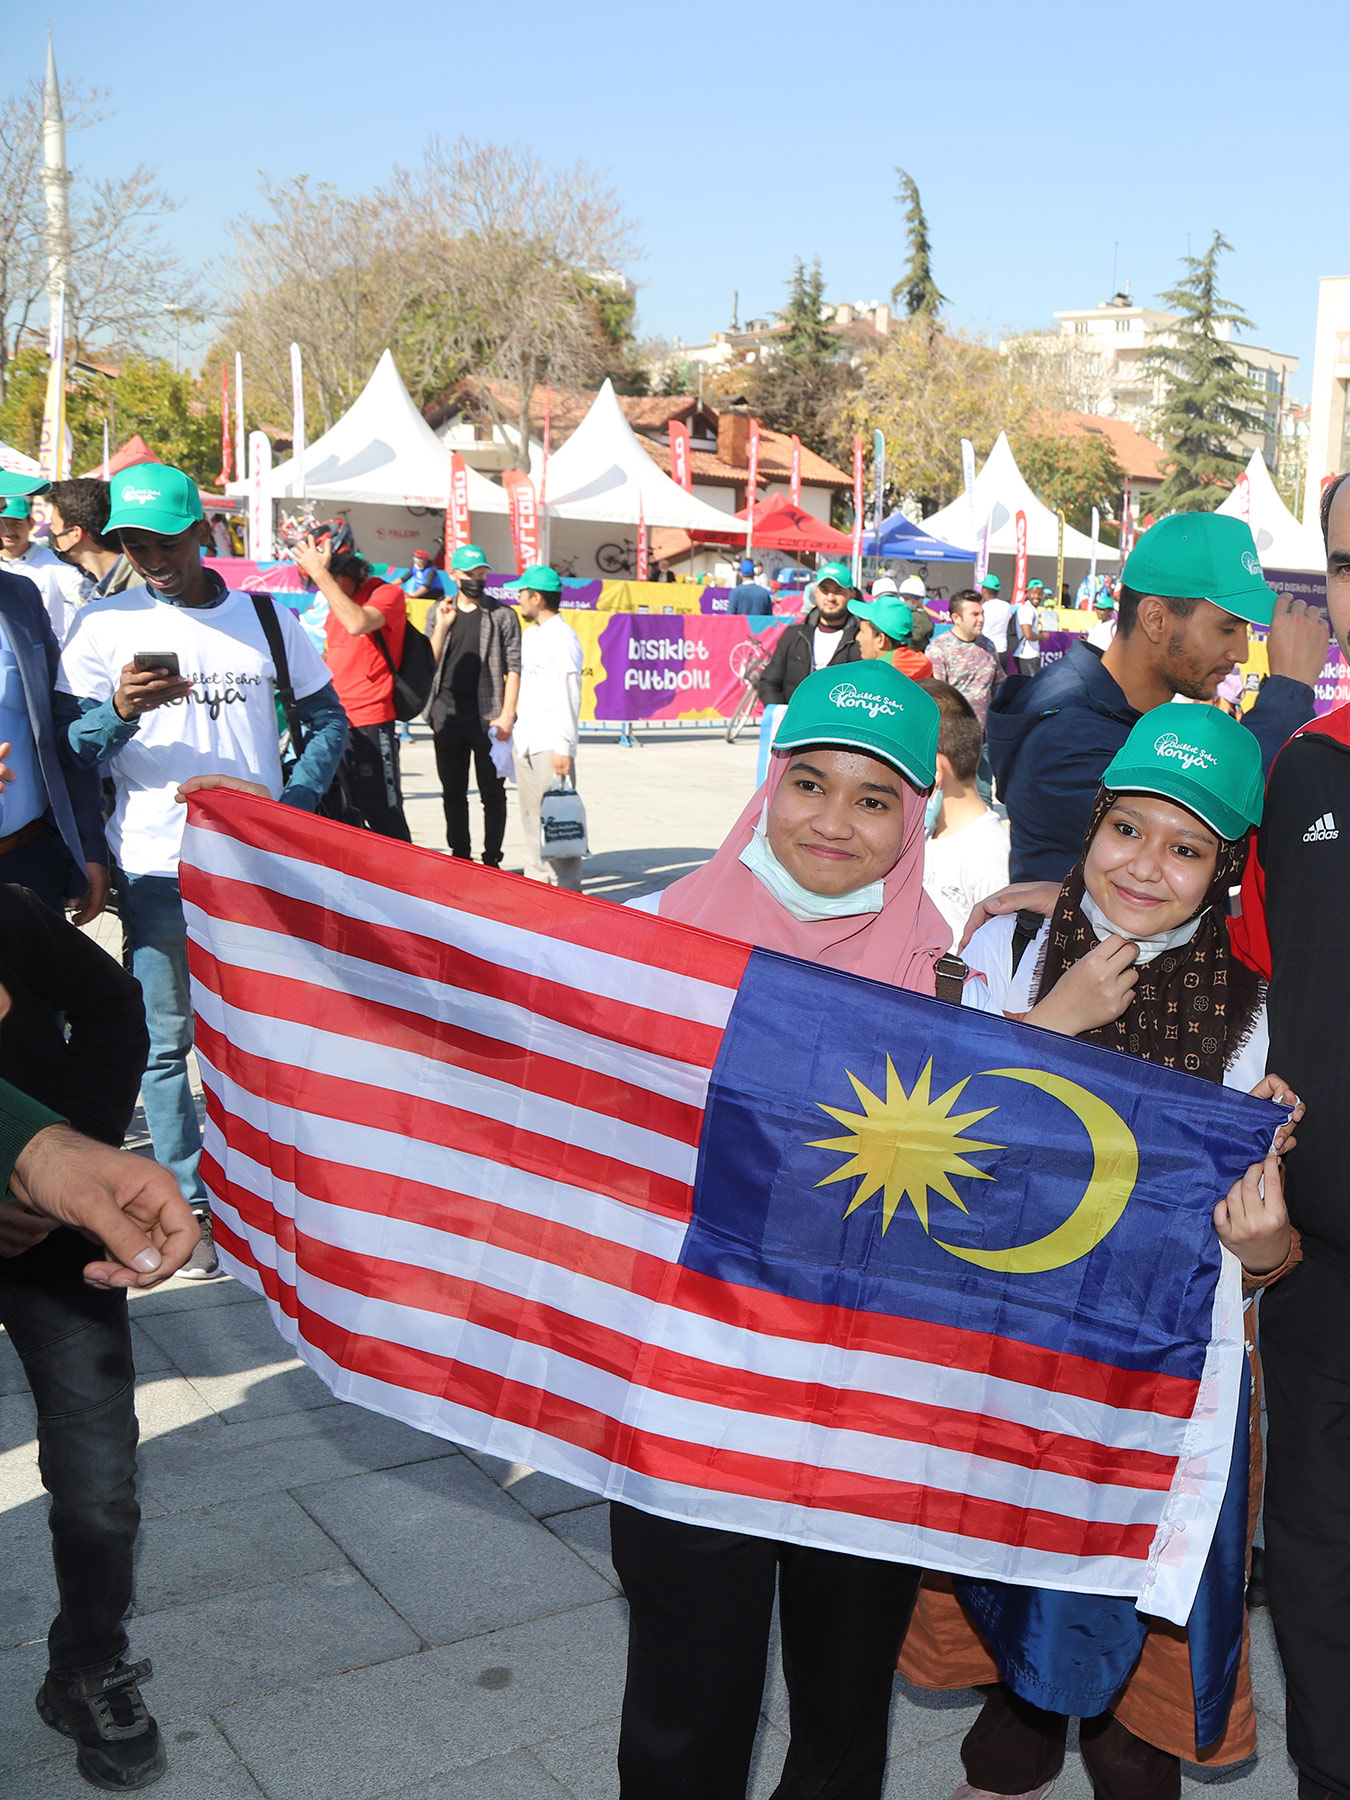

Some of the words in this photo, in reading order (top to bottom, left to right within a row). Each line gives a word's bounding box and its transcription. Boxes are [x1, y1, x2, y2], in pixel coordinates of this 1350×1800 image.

[628, 637, 710, 660] bisiklet
[624, 668, 710, 691] futbolu
[836, 692, 896, 719] Konya
[1157, 741, 1209, 770] Konya
[1303, 829, 1340, 842] adidas
